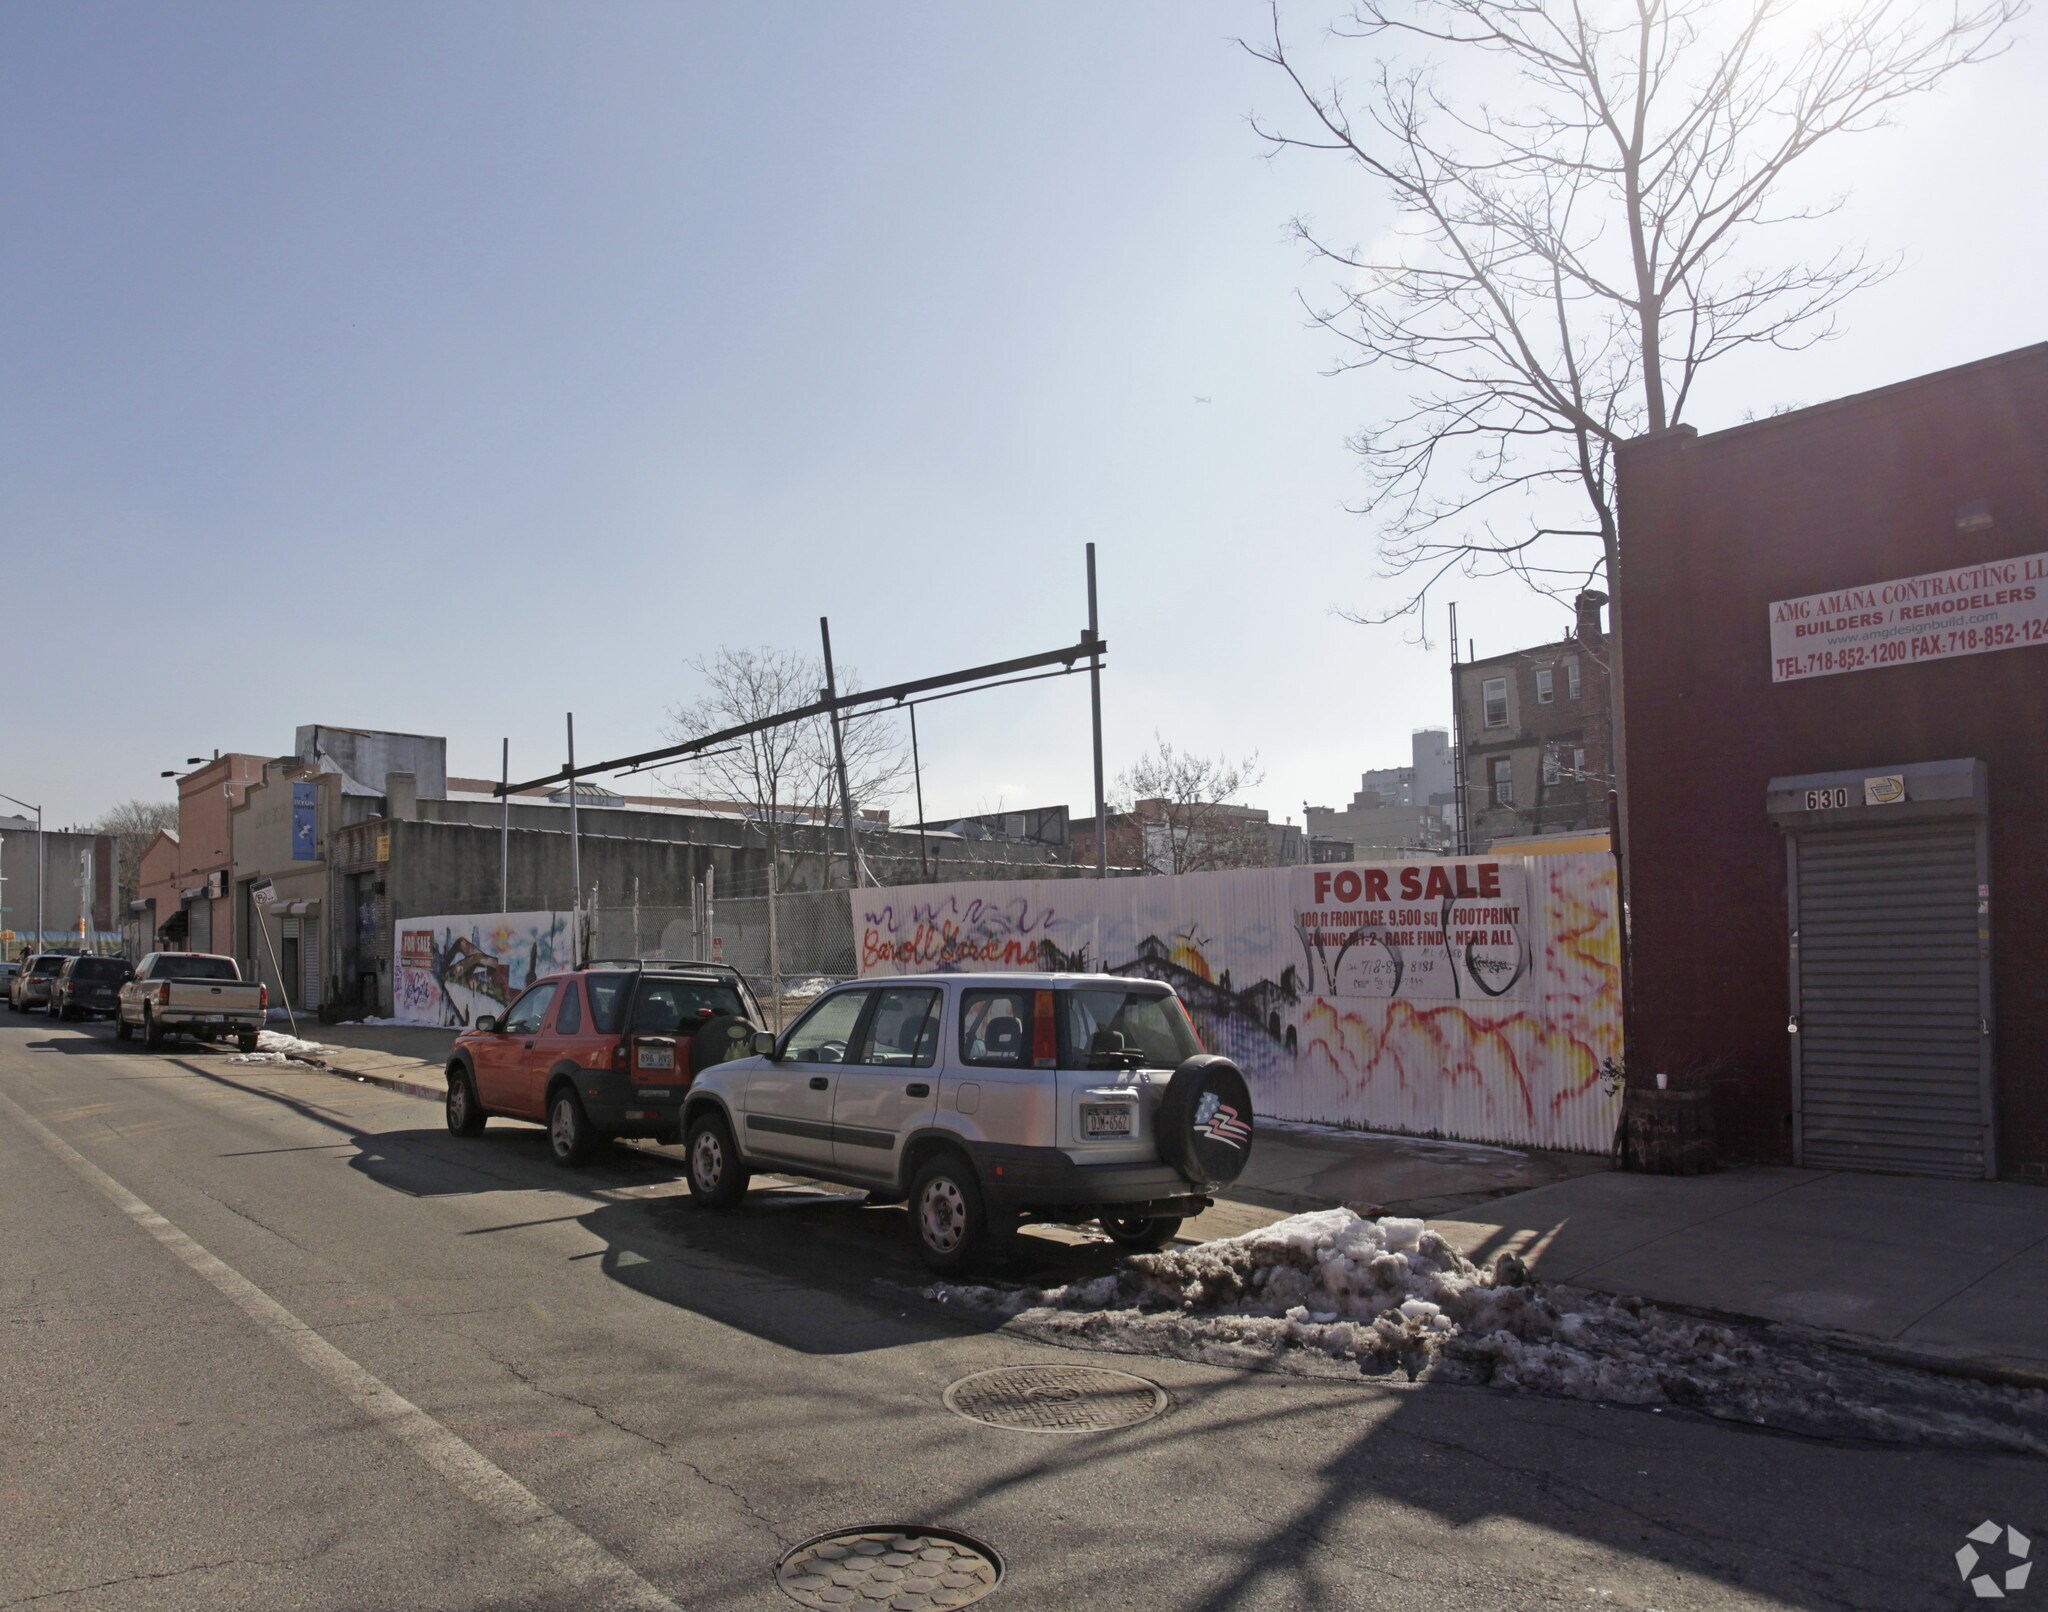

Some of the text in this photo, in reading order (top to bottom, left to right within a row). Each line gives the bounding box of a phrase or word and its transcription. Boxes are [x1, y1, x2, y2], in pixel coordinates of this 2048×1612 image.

[1774, 600, 1811, 624] AMG
[1882, 564, 2016, 605] CONTRACTING
[1795, 612, 1884, 638] BUILDERS
[1900, 586, 2037, 622] REMODELERS
[1827, 610, 1999, 646] www.amgdesignbuild.com
[1806, 787, 1847, 810] 630
[1314, 863, 1502, 903] FOR SALE
[1300, 912, 1319, 927] 100
[1320, 912, 1329, 927] ft
[1388, 909, 1422, 927] 9,500
[1424, 913, 1438, 928] sq
[1453, 907, 1520, 926] FOOTPRINT
[404, 935, 431, 953] FOR SALE
[1308, 931, 1347, 947] ZONING
[1385, 931, 1415, 946] RARE
[1417, 931, 1444, 946] FIND
[1455, 930, 1489, 946] NEAR
[1491, 930, 1514, 946] ALL
